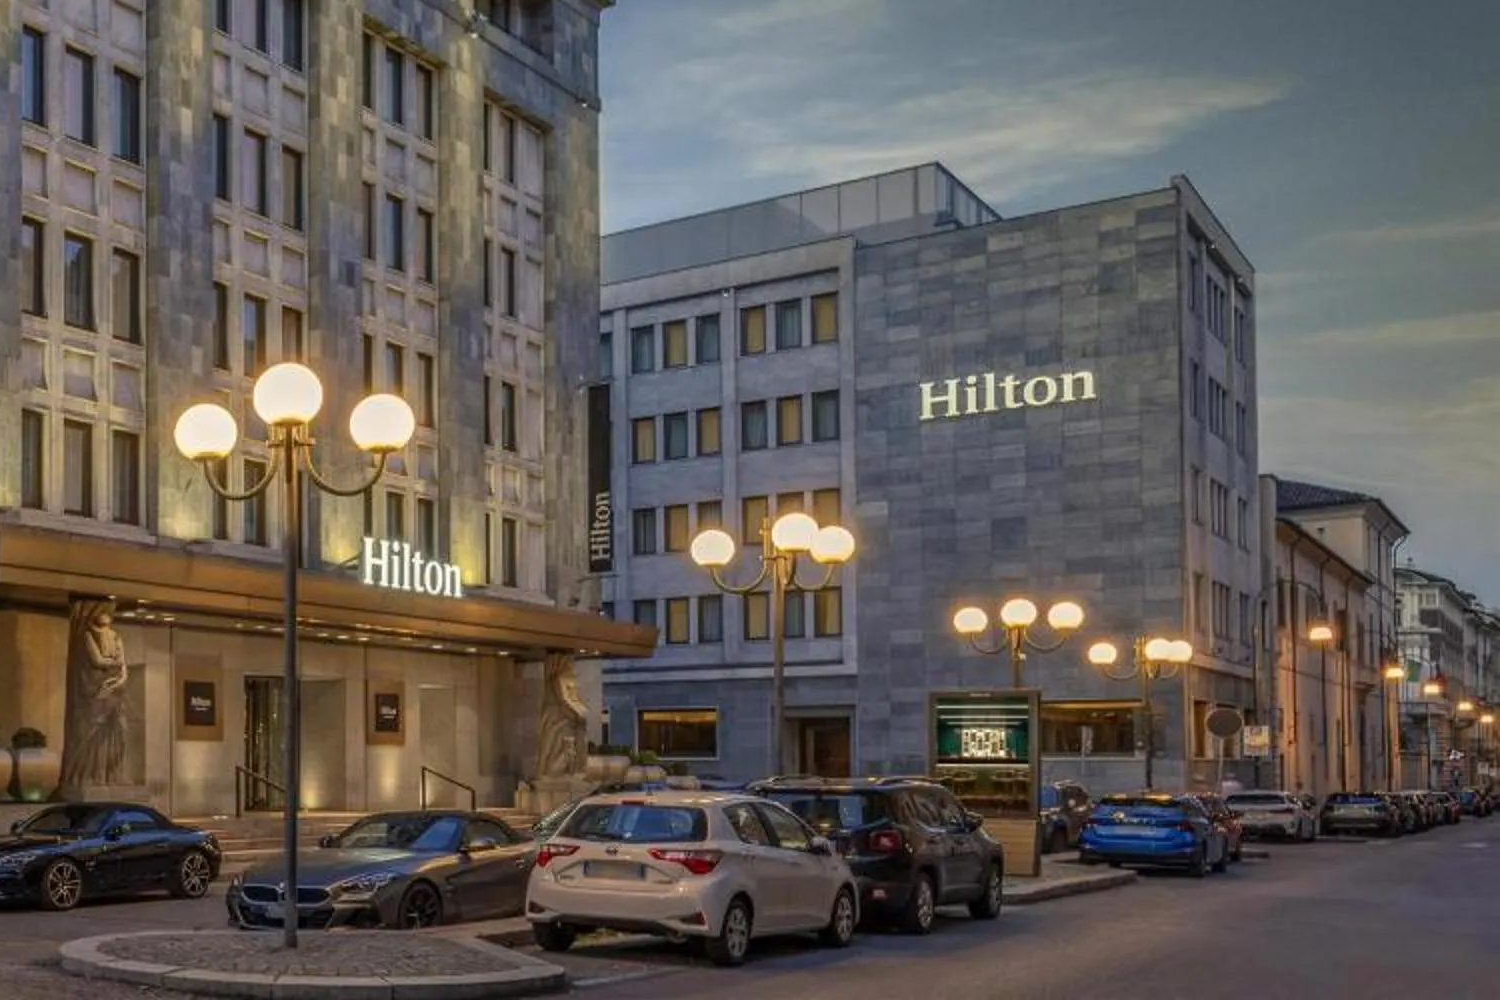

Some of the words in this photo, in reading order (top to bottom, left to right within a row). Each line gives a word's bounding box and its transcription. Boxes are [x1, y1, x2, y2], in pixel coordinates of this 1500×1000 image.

[919, 370, 1097, 421] Hilton
[590, 492, 611, 561] Hilton
[363, 537, 462, 597] Hilton
